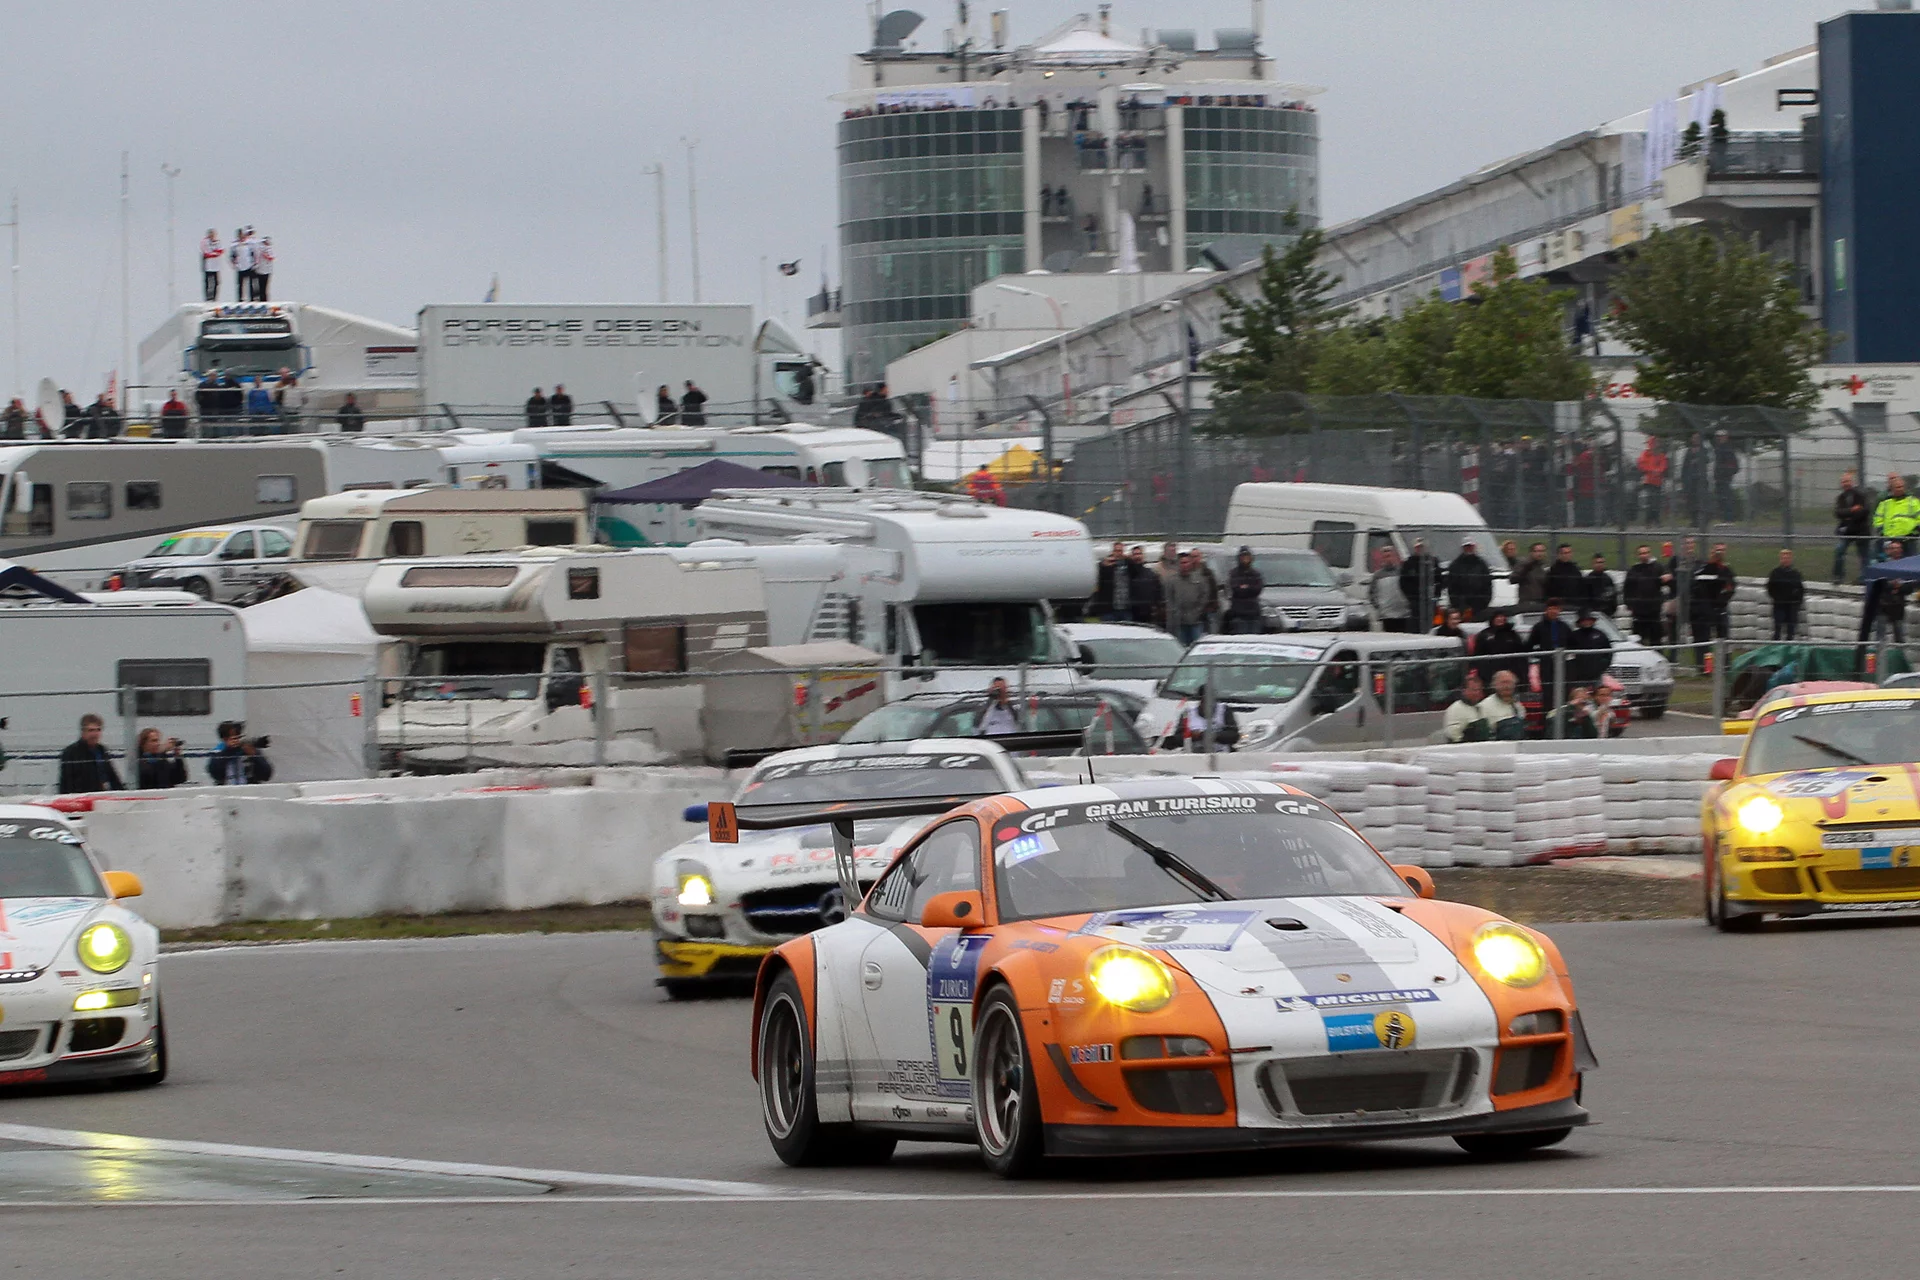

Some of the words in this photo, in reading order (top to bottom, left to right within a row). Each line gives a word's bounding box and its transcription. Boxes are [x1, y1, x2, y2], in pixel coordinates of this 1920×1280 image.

[443, 319, 584, 332] PORSCHE
[593, 319, 702, 332] DESIGN
[583, 335, 744, 348] SELECTION
[1778, 781, 1832, 793] 56
[1085, 801, 1149, 817] GRAN
[1155, 796, 1257, 811] TURISMO
[1086, 815, 1110, 823] THE
[1143, 809, 1190, 818] DRIVING
[1141, 926, 1188, 943] 9
[939, 979, 969, 997] ZURICH
[1315, 990, 1431, 1005] MICHELIN
[1327, 1023, 1374, 1037] BILSTEIN
[950, 1007, 967, 1076] 9
[1070, 1046, 1098, 1063] Mobil
[1101, 1045, 1113, 1062] 1
[897, 1060, 934, 1073] PORSCHE
[887, 1071, 937, 1084] INTELLIGENT
[877, 1082, 938, 1096] PERFORMANCE
